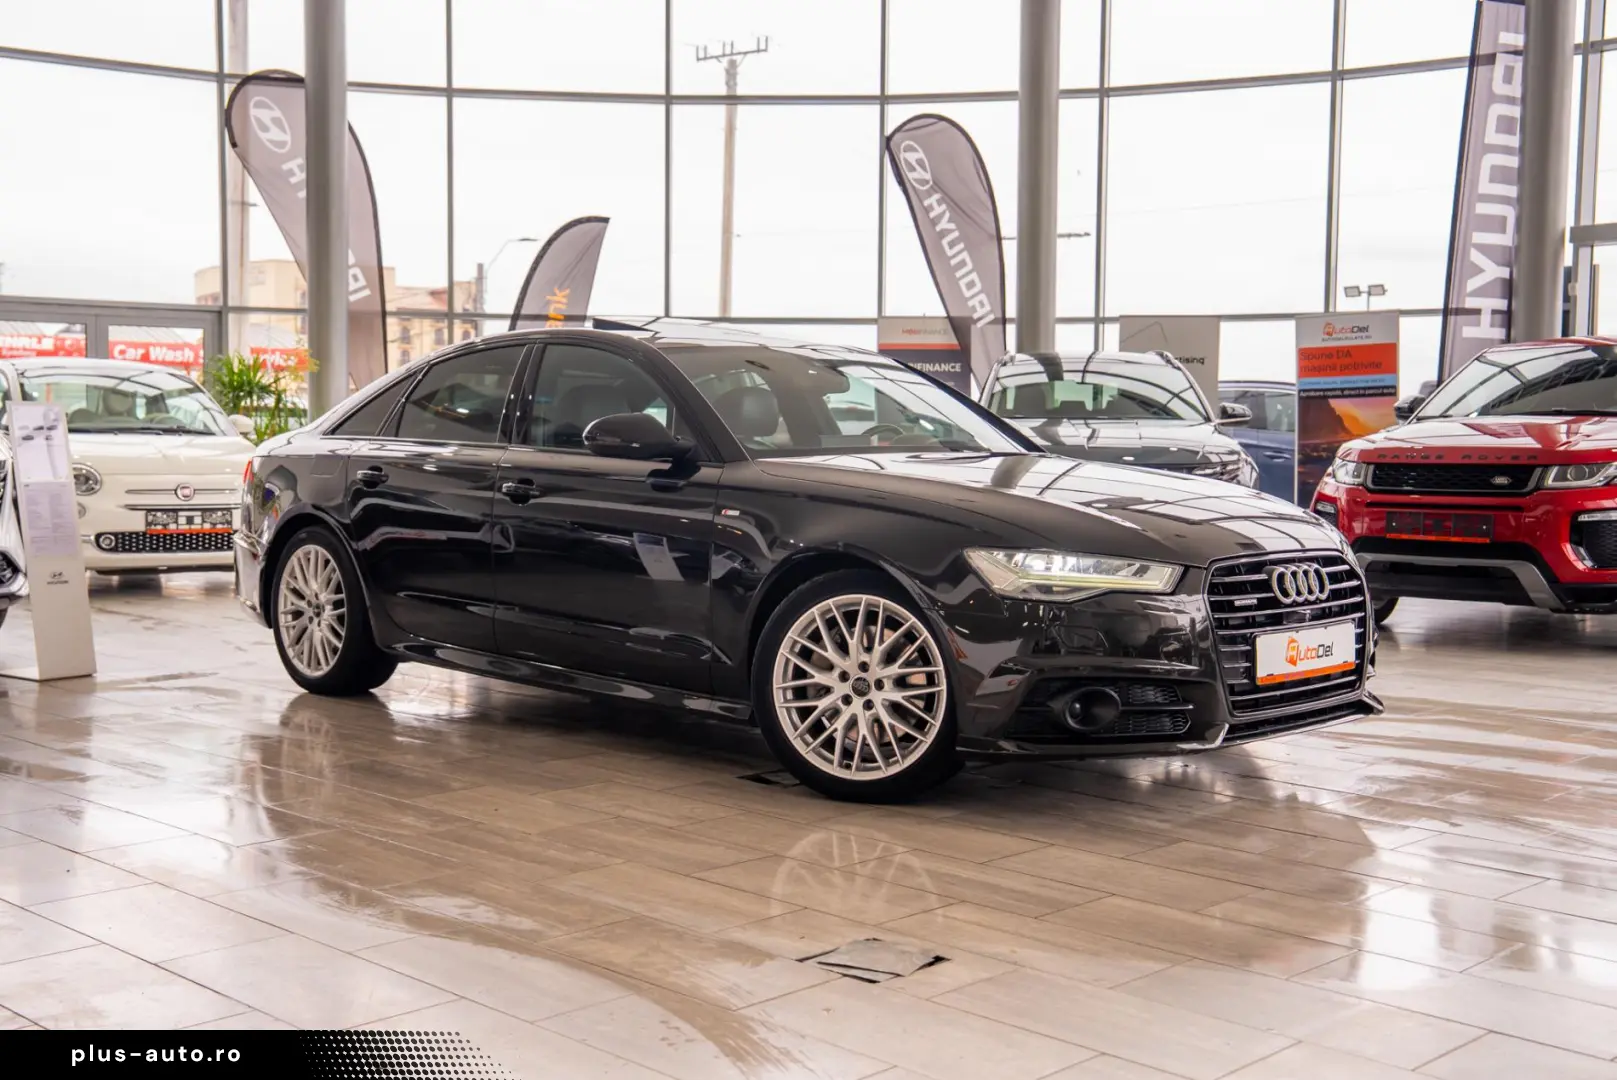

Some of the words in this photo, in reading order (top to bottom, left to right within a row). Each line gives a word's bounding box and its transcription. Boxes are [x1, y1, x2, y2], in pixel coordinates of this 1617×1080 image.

[1462, 31, 1525, 340] HYUNDAI
[923, 192, 996, 328] HYUNDAI
[113, 344, 145, 360] Car
[148, 346, 194, 363] Wash
[1300, 350, 1333, 362] Spune
[1336, 349, 1352, 359] DA
[1377, 453, 1444, 461] RANGE
[1286, 636, 1334, 667] AutoDel
